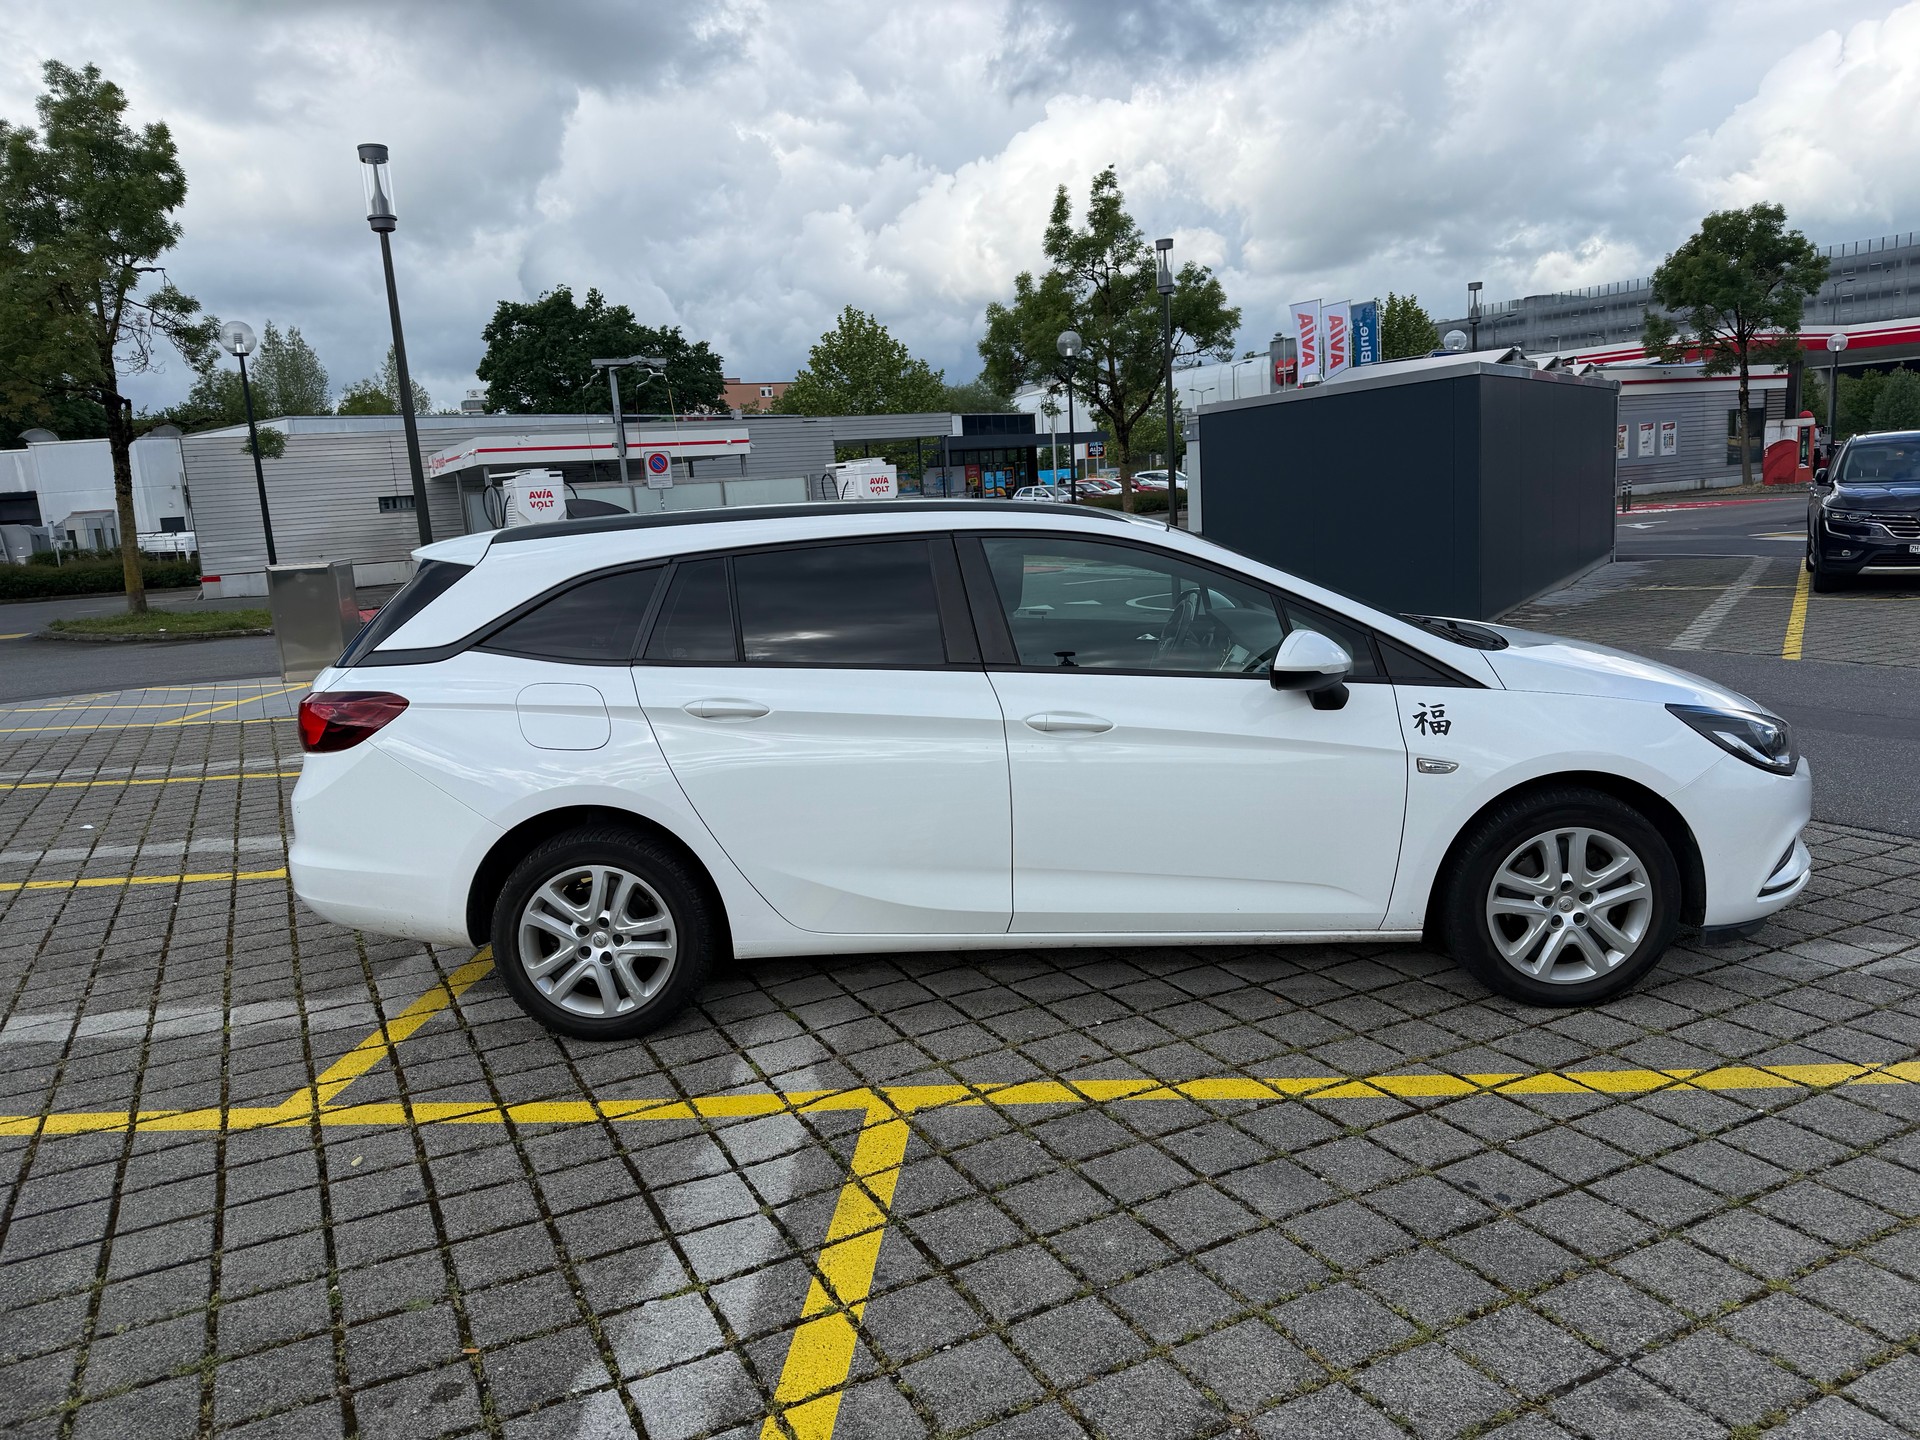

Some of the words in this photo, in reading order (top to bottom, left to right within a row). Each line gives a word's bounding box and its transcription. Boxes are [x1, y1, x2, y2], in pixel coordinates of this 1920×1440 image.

[870, 475, 889, 485] AVIA
[529, 489, 553, 499] AVIA
[870, 485, 890, 496] VOLT
[530, 500, 554, 511] VOLT
[1412, 702, 1452, 736] 福
